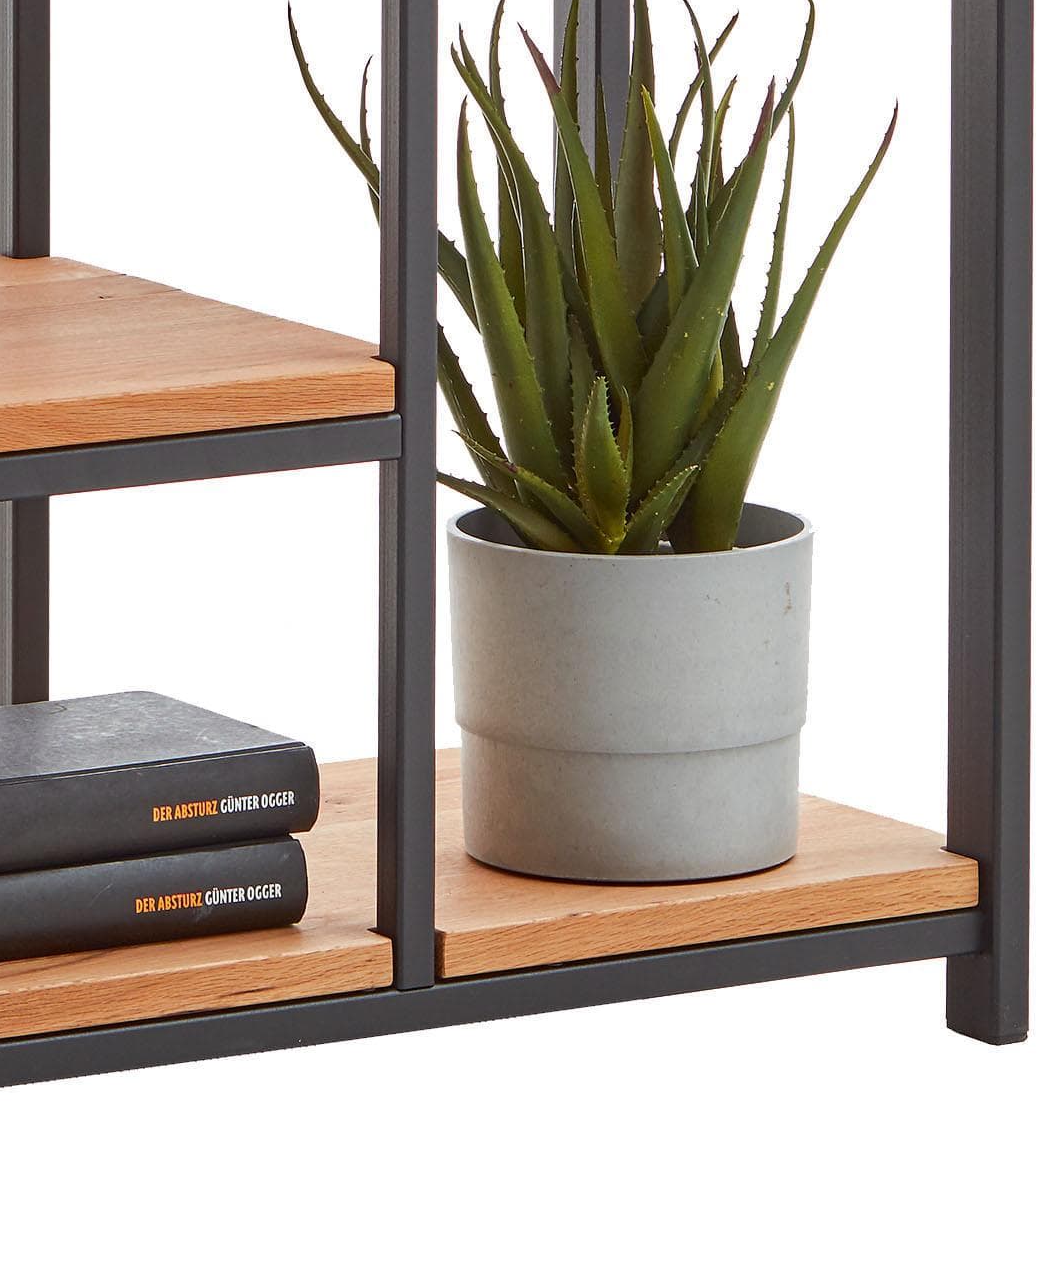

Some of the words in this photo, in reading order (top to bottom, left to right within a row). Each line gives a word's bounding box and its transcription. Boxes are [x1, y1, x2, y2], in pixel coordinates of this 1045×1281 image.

[152, 804, 173, 822] DER
[174, 799, 219, 820] ABSTURZ
[220, 795, 260, 814] GÜNTER
[261, 790, 295, 809] OGGER
[135, 897, 156, 914] DER
[157, 891, 203, 911] ABSTURZ
[204, 887, 246, 906] GÜNTER
[247, 883, 282, 901] OGGER
